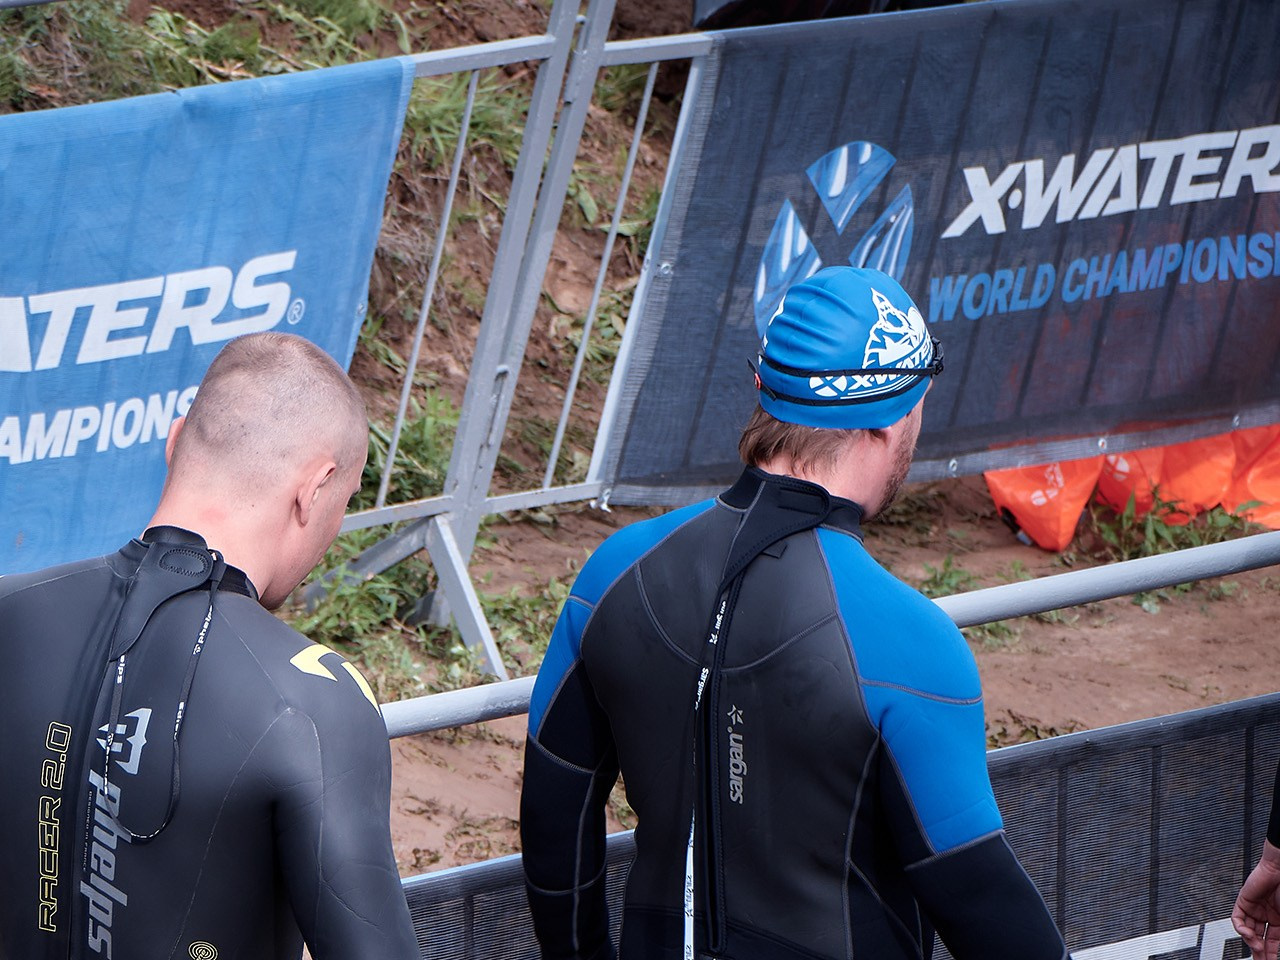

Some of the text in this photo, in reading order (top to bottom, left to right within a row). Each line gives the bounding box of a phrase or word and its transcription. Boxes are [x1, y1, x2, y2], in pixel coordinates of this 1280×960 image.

[929, 232, 1280, 323] WORLD CHAMPIONS
[38, 721, 72, 933] RACER 2.0
[729, 732, 747, 805] sargan
[80, 769, 132, 960] phelps
